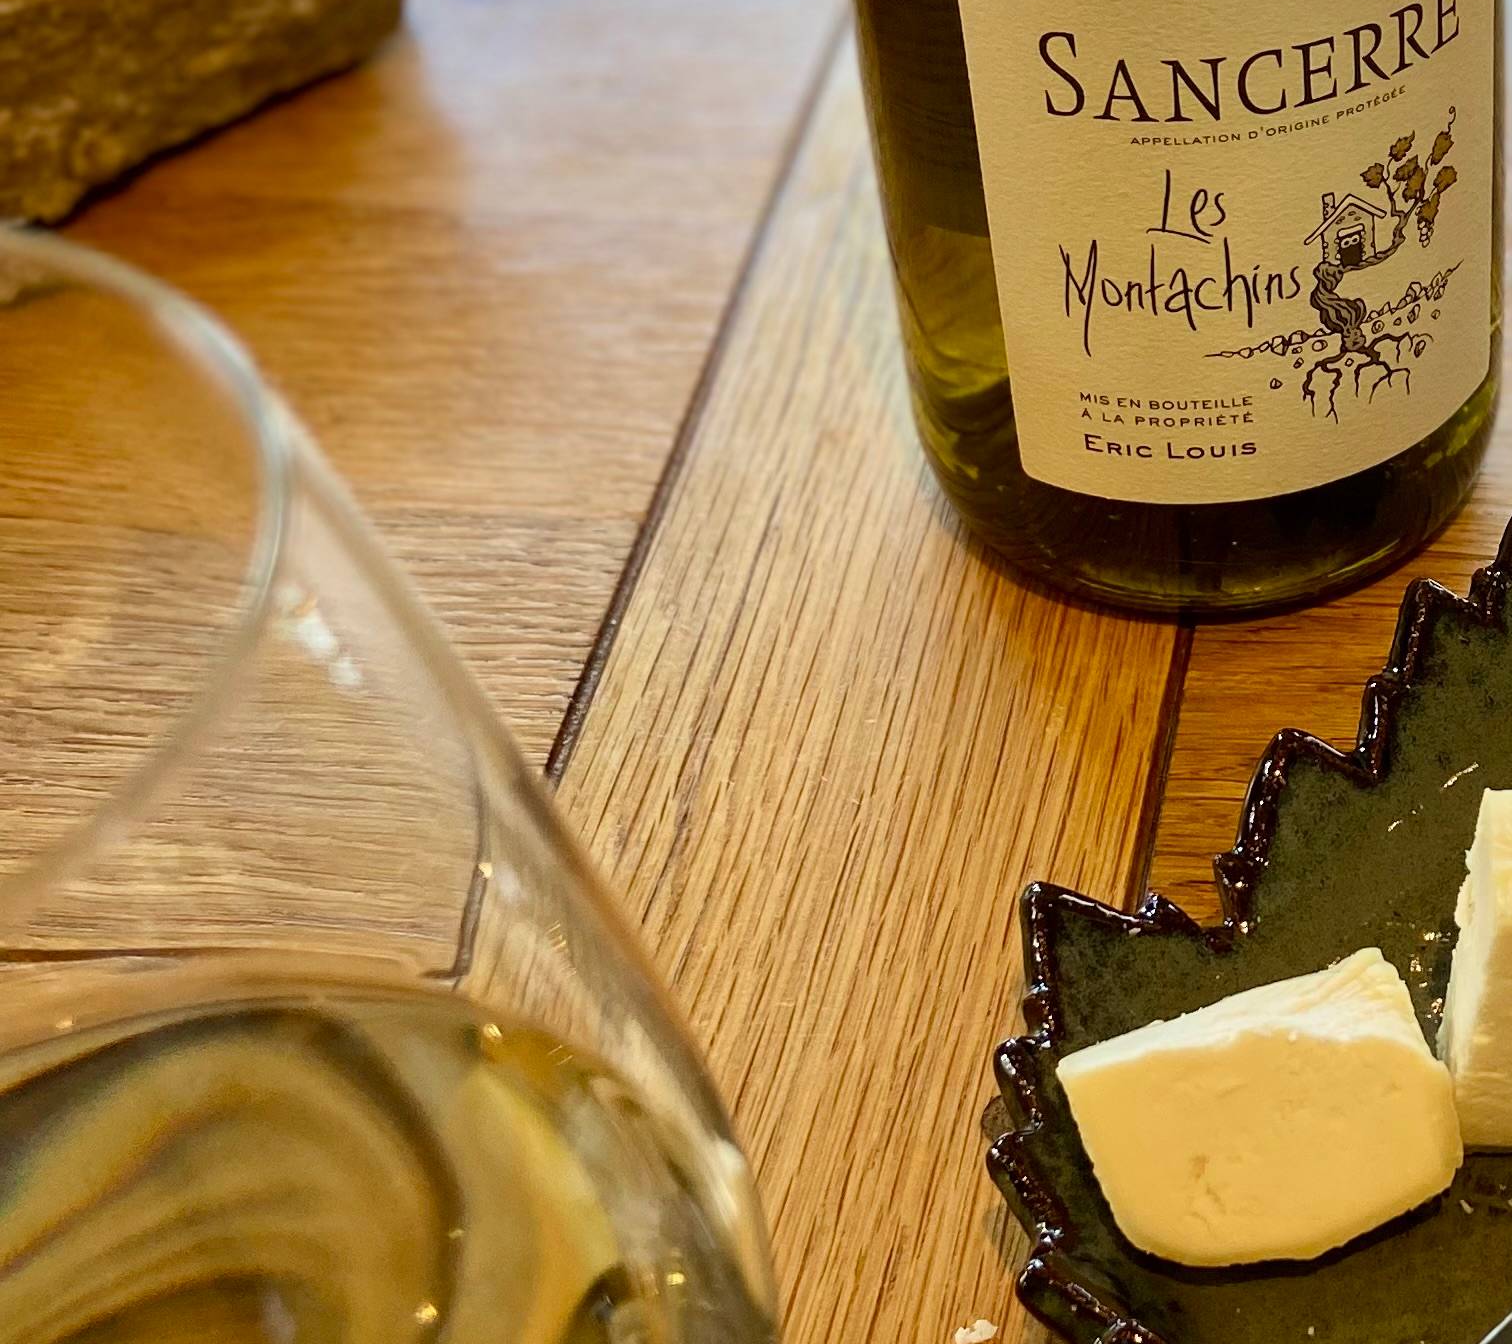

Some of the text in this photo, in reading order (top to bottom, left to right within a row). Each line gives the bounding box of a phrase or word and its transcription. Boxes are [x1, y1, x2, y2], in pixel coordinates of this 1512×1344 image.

[1130, 132, 1241, 146] APPELLATION
[1248, 114, 1330, 139] D'ORIGINE
[1145, 169, 1227, 244] Les
[1058, 236, 1300, 357] Montachins
[1080, 391, 1254, 411] MIS EN BOUTEILLE
[1102, 412, 1125, 425] LA
